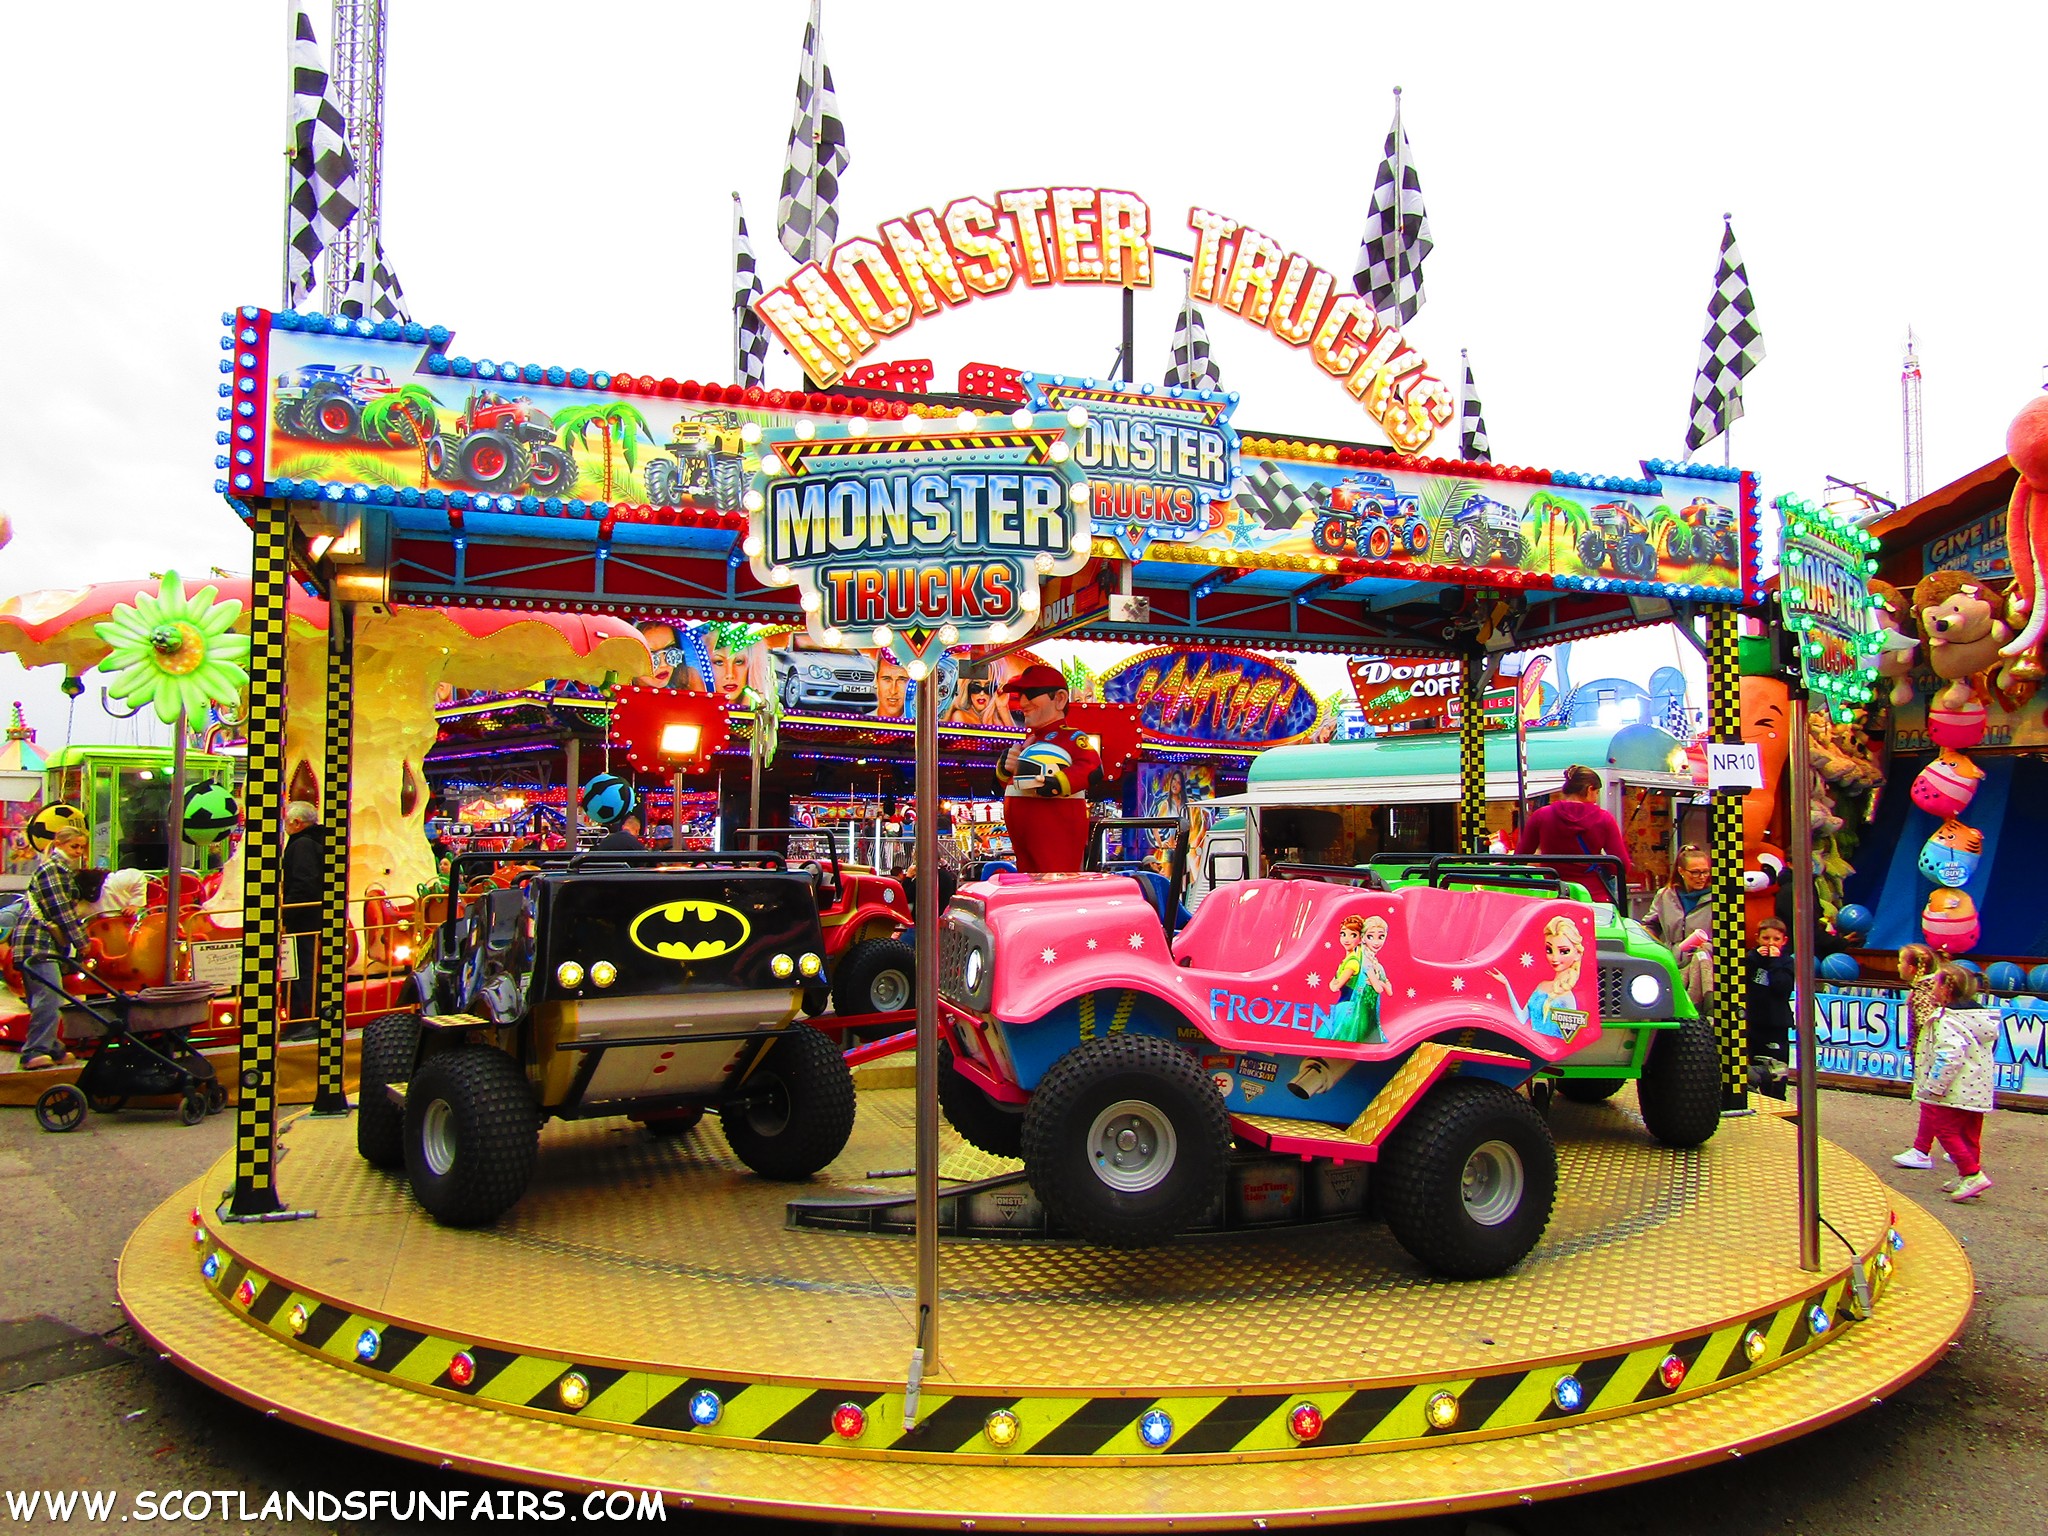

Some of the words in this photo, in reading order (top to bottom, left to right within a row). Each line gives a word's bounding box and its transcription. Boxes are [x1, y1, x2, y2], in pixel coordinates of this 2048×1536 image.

[758, 188, 1152, 387] MONSTER
[1190, 207, 1454, 453] TRUCKS
[1074, 418, 1225, 482] ONSTER
[776, 474, 1065, 560] MONSTER
[1088, 479, 1194, 523] RUCKS
[1931, 523, 1982, 563] GIVE
[828, 564, 1012, 621] TRUCKS
[1369, 686, 1400, 709] FRESH
[1451, 696, 1514, 712] WLES
[1713, 754, 1756, 770] NR10
[1210, 987, 1337, 1037] FROZEN
[1552, 1013, 1586, 1025] MONSTER
[1790, 1000, 1888, 1046] ALLS
[1815, 1046, 1850, 1071] FUN
[1857, 1051, 1895, 1076] FOR
[1243, 1183, 1288, 1193] FunTime
